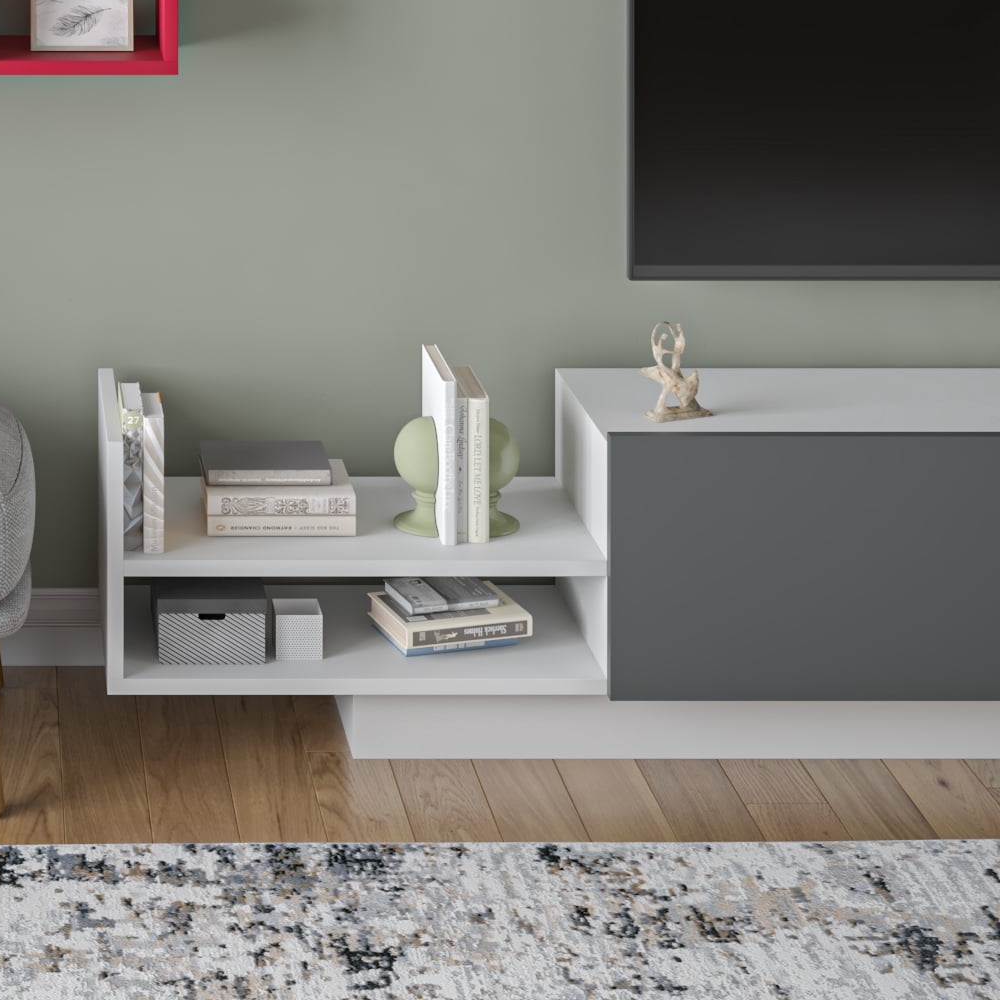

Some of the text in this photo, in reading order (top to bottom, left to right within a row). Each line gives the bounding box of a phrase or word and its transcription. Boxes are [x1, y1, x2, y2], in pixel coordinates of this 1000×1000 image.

[127, 416, 140, 425] 27
[473, 457, 482, 473] LET
[473, 473, 482, 485] ME
[473, 486, 482, 505] LOVE
[463, 625, 507, 637] Sherlock Holmes
